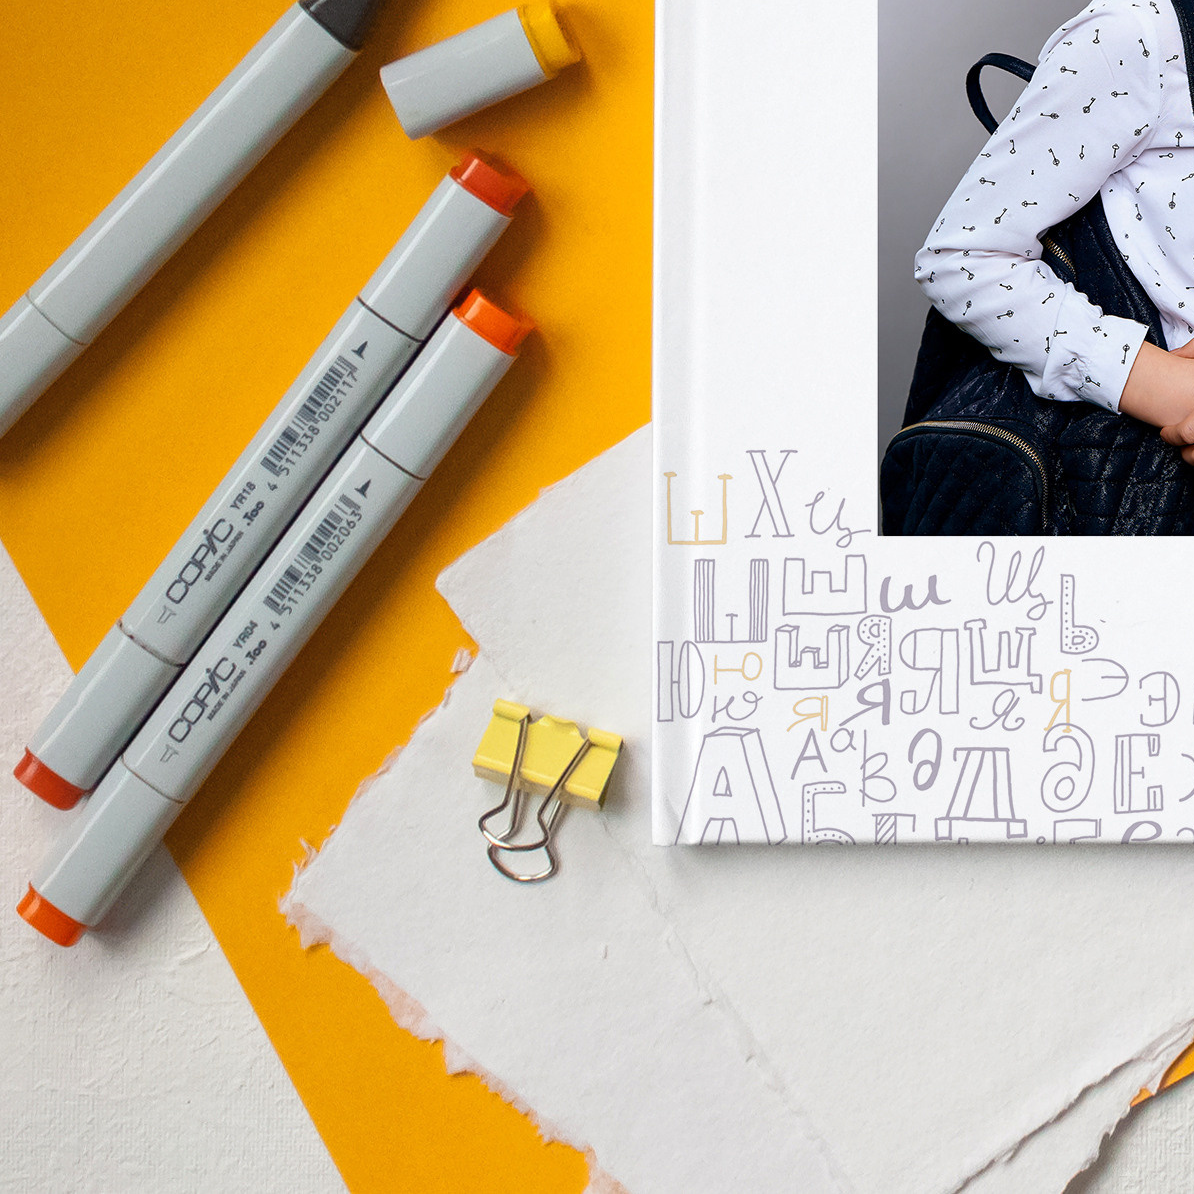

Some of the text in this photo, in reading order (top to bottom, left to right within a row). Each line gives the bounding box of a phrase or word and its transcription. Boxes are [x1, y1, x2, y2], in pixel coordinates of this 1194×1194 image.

[268, 370, 359, 492] 4 511338 002117
[271, 509, 363, 631] 4 511338 002063
